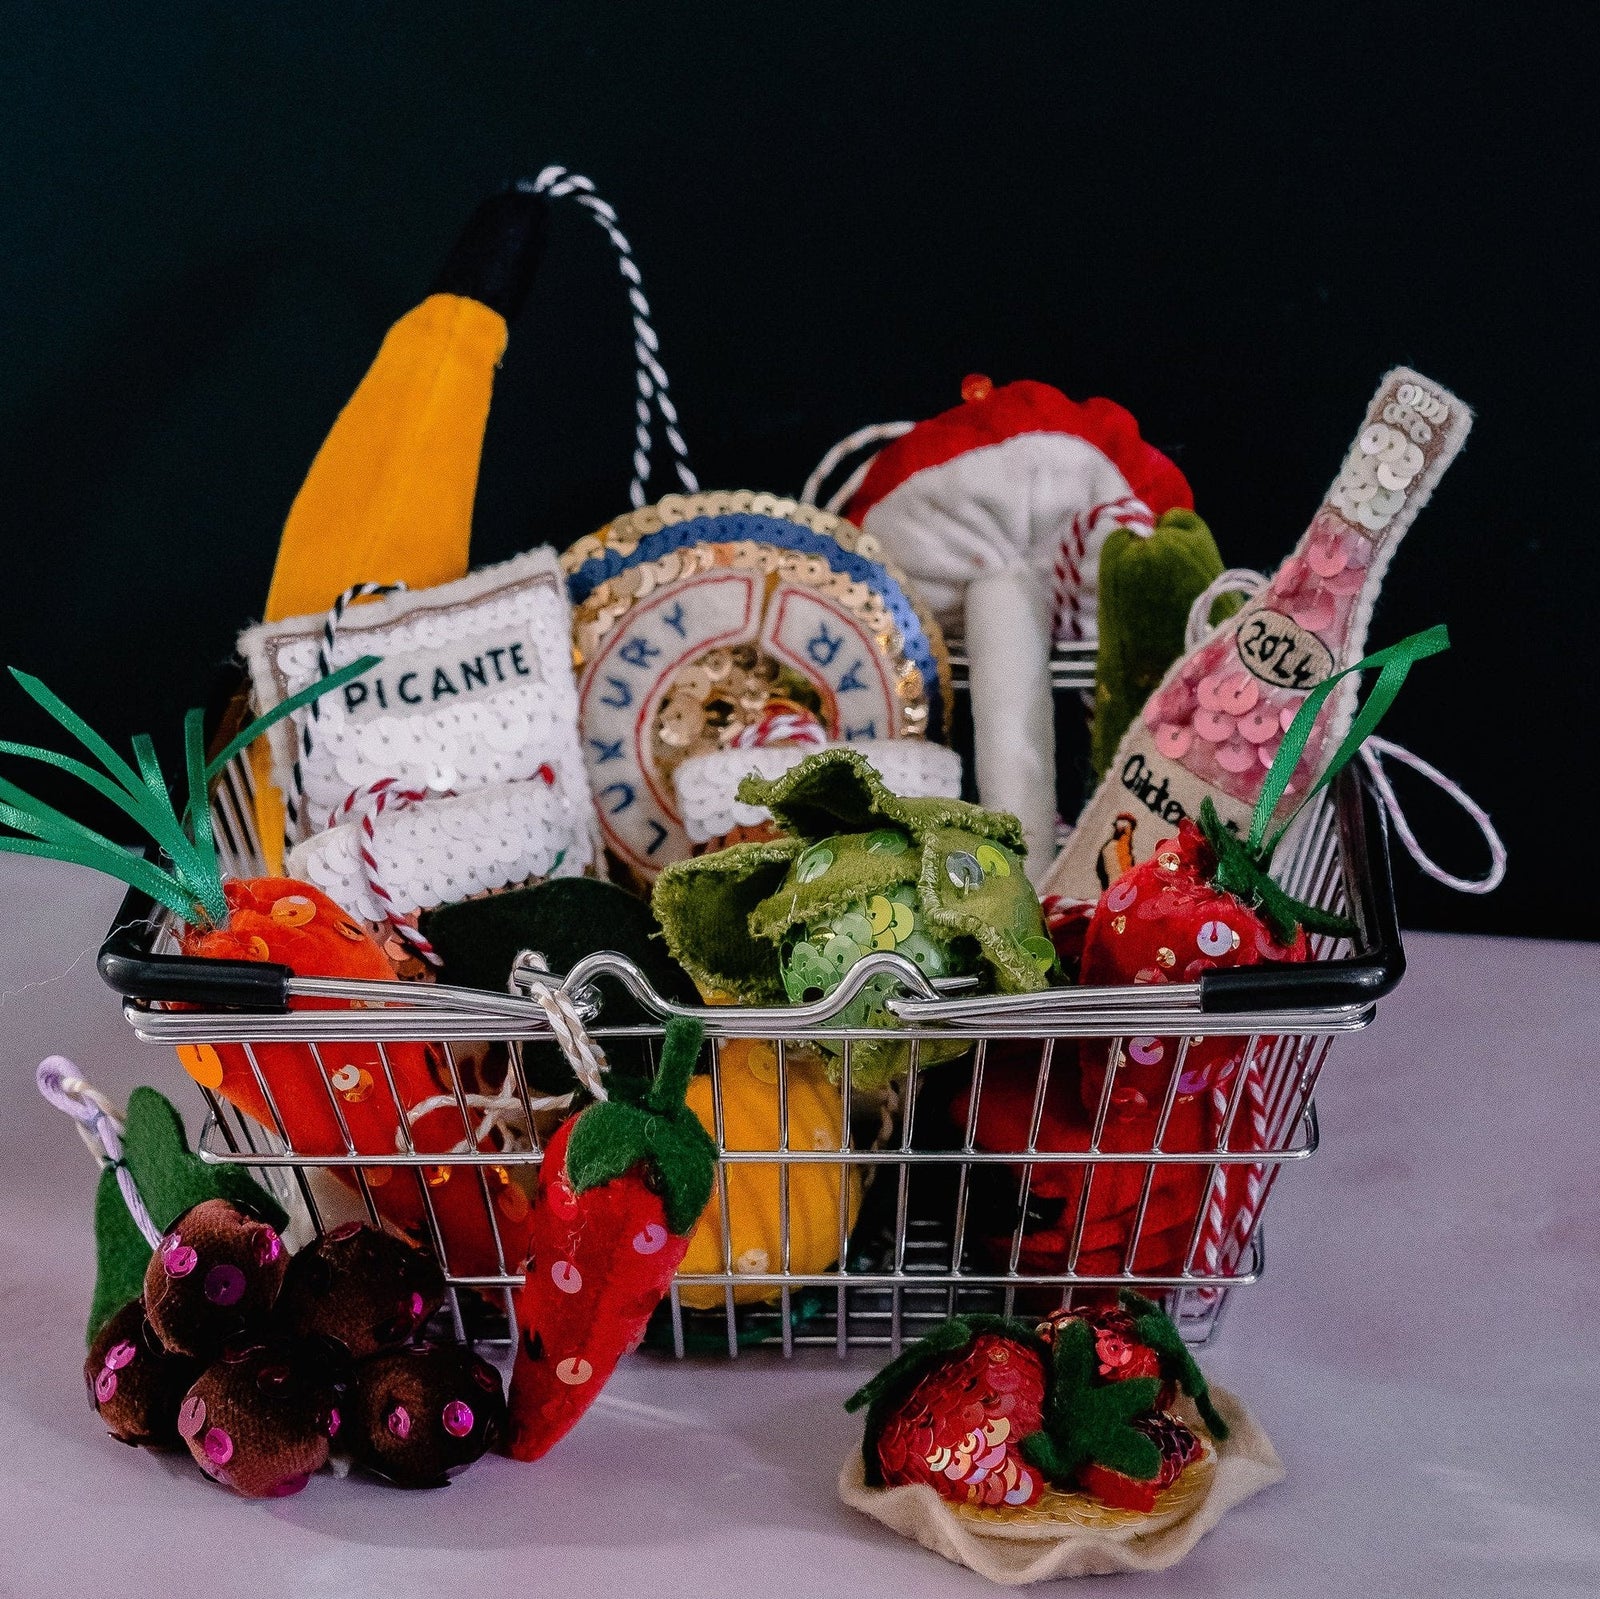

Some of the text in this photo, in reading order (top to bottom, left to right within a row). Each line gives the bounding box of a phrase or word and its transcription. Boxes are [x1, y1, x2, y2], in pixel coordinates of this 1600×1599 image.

[344, 642, 529, 713] PICANTE
[807, 622, 877, 741] IAR
[1244, 620, 1314, 688] 2024
[590, 602, 687, 854] LUXURY
